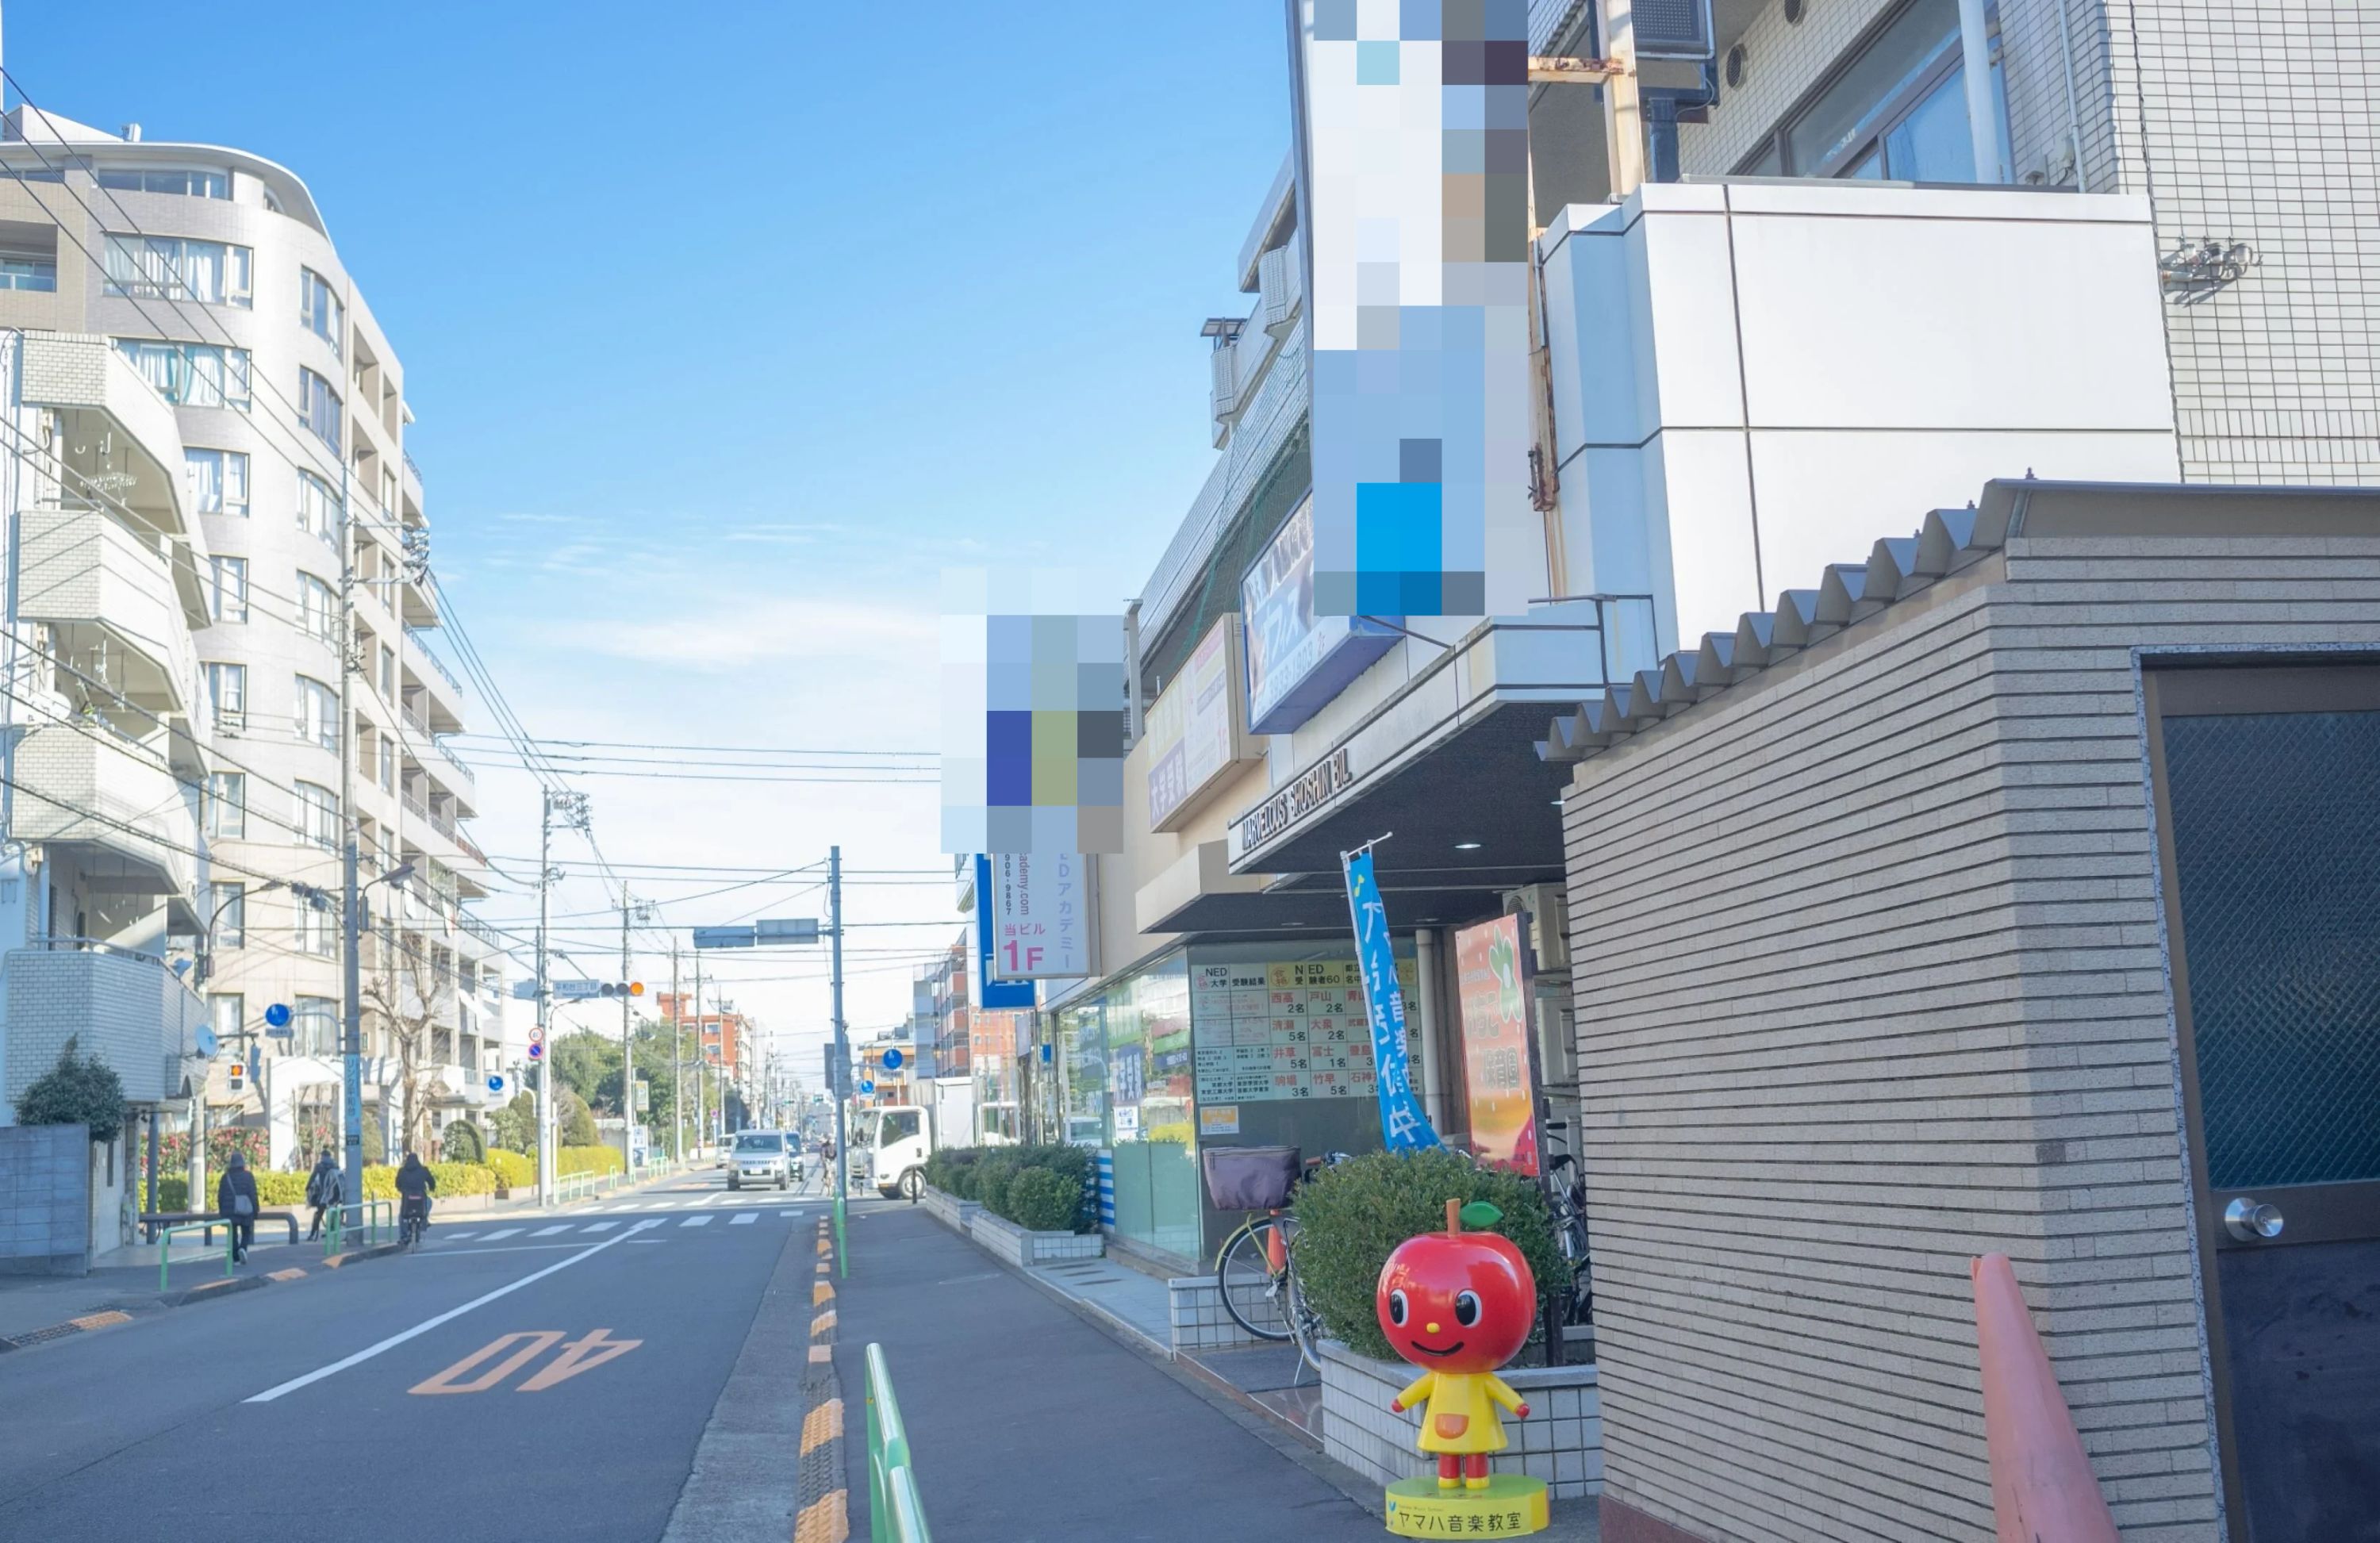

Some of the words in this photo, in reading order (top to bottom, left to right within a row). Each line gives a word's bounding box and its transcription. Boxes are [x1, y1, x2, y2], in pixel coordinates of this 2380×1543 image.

[1242, 793, 1288, 851] MARVELOUS
[1291, 760, 1332, 816] SHOSHIN
[1004, 923, 1046, 936] 当ビル
[1003, 939, 1044, 971] 1F
[1206, 967, 1227, 977] NED
[1271, 992, 1294, 1004] 西高
[1310, 991, 1331, 1002] 戸山
[1288, 1004, 1305, 1013] 2名
[1326, 1003, 1343, 1013] 2名
[1311, 1019, 1333, 1030] 大泉
[1289, 1031, 1306, 1042] 5名
[1328, 1030, 1345, 1040] 2名
[1410, 1028, 1419, 1038] 名
[1273, 1046, 1296, 1058] 井草
[1290, 1058, 1307, 1069] 5名
[1330, 1057, 1346, 1068] 1名
[1313, 1073, 1335, 1084] 竹早
[1292, 1087, 1309, 1097] 3名
[1330, 1085, 1348, 1096] 5名
[1368, 1084, 1379, 1094] 3
[407, 1328, 644, 1395] 40
[1398, 1510, 1522, 1533] ヤマハ音楽教室
